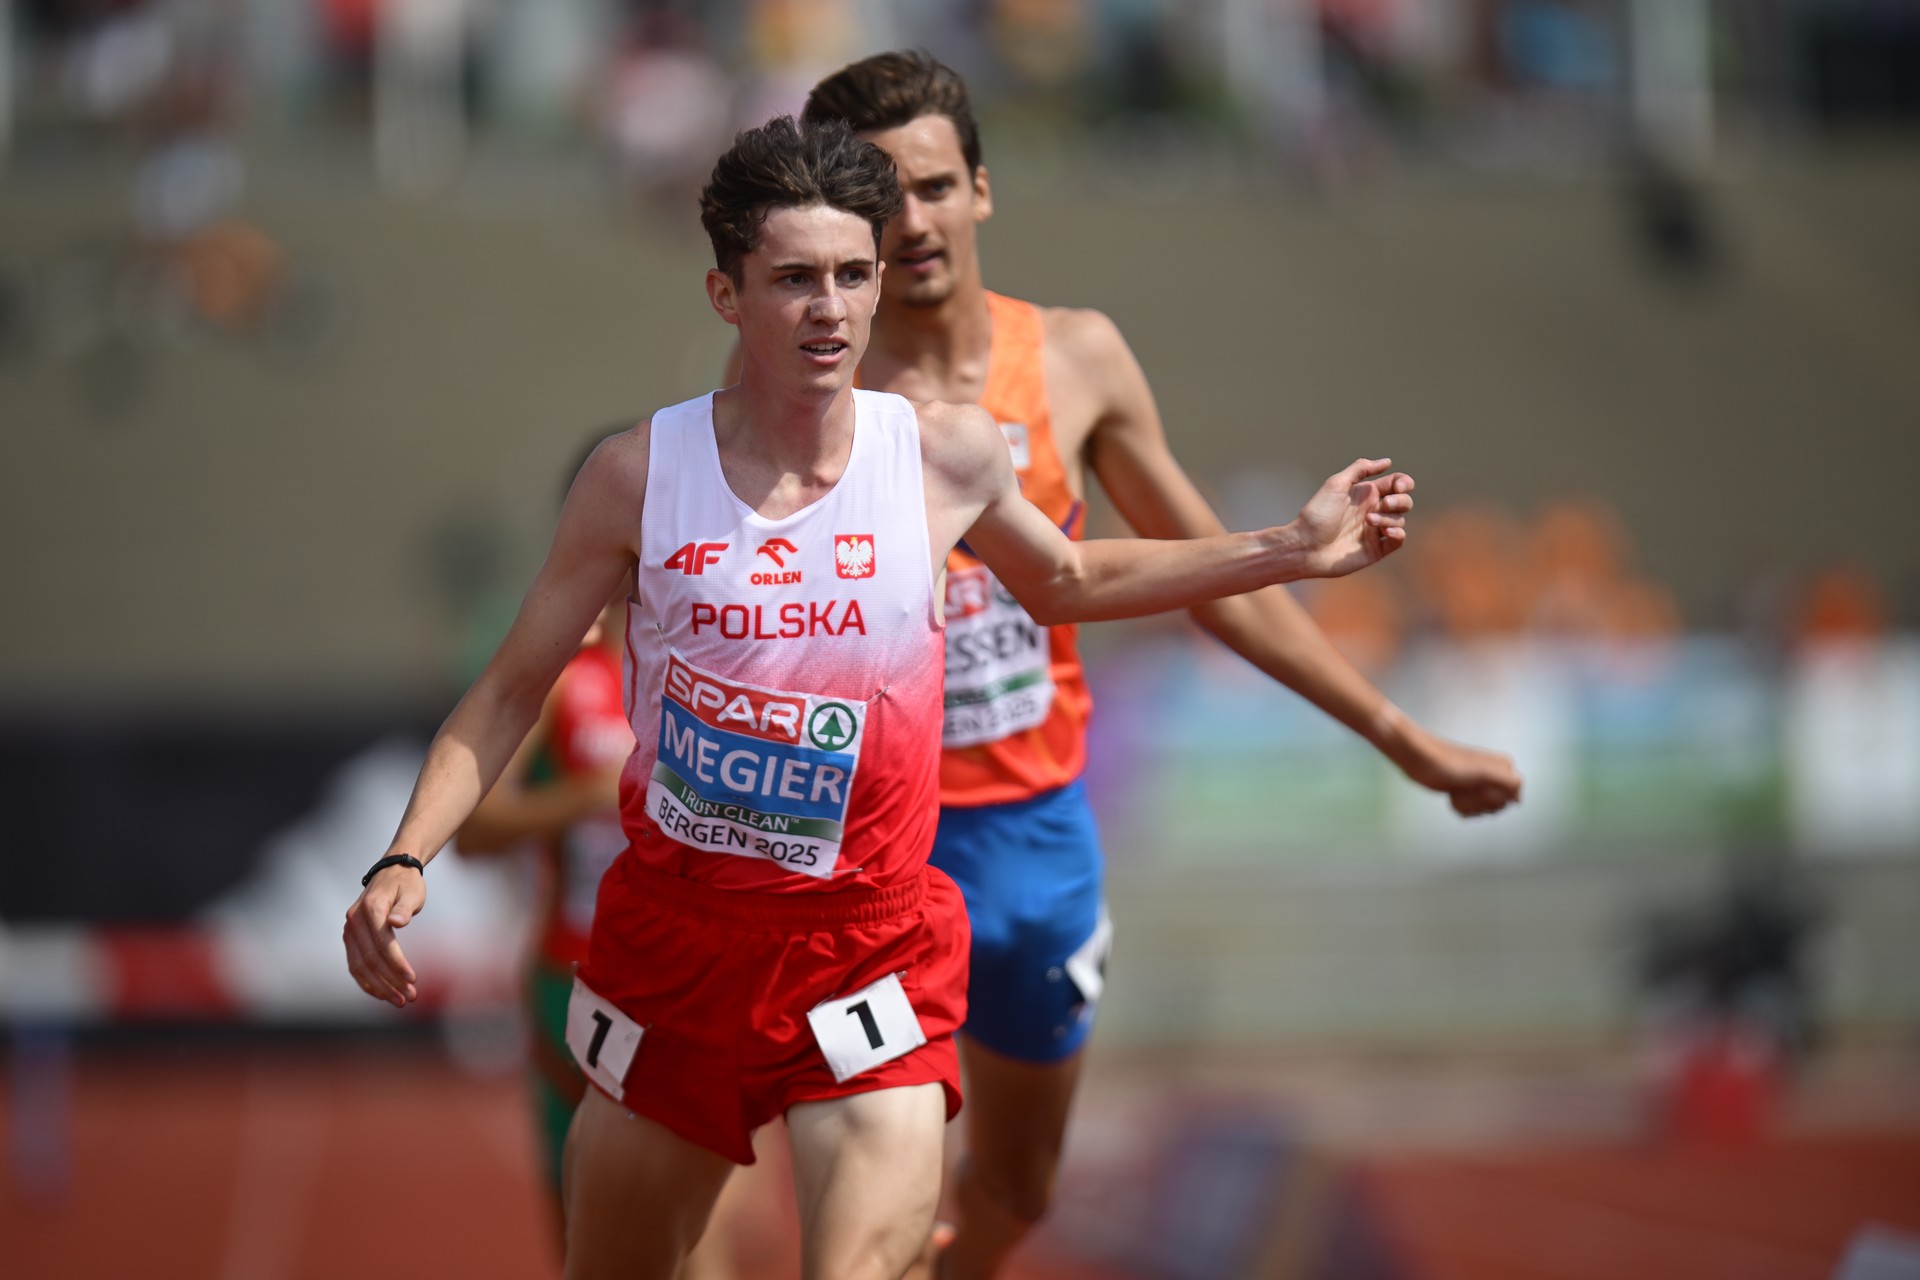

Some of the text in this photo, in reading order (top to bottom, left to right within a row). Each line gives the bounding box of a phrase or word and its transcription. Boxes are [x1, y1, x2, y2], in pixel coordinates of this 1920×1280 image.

[663, 542, 730, 575] 4F
[750, 571, 802, 585] ORLEN
[691, 599, 867, 640] POLSKA
[667, 664, 800, 738] SPAR
[664, 710, 845, 804] MEGIER
[685, 792, 719, 816] RUN
[658, 796, 820, 867] BERGEN 2025
[591, 1009, 613, 1068] 1
[846, 999, 885, 1050] 1
